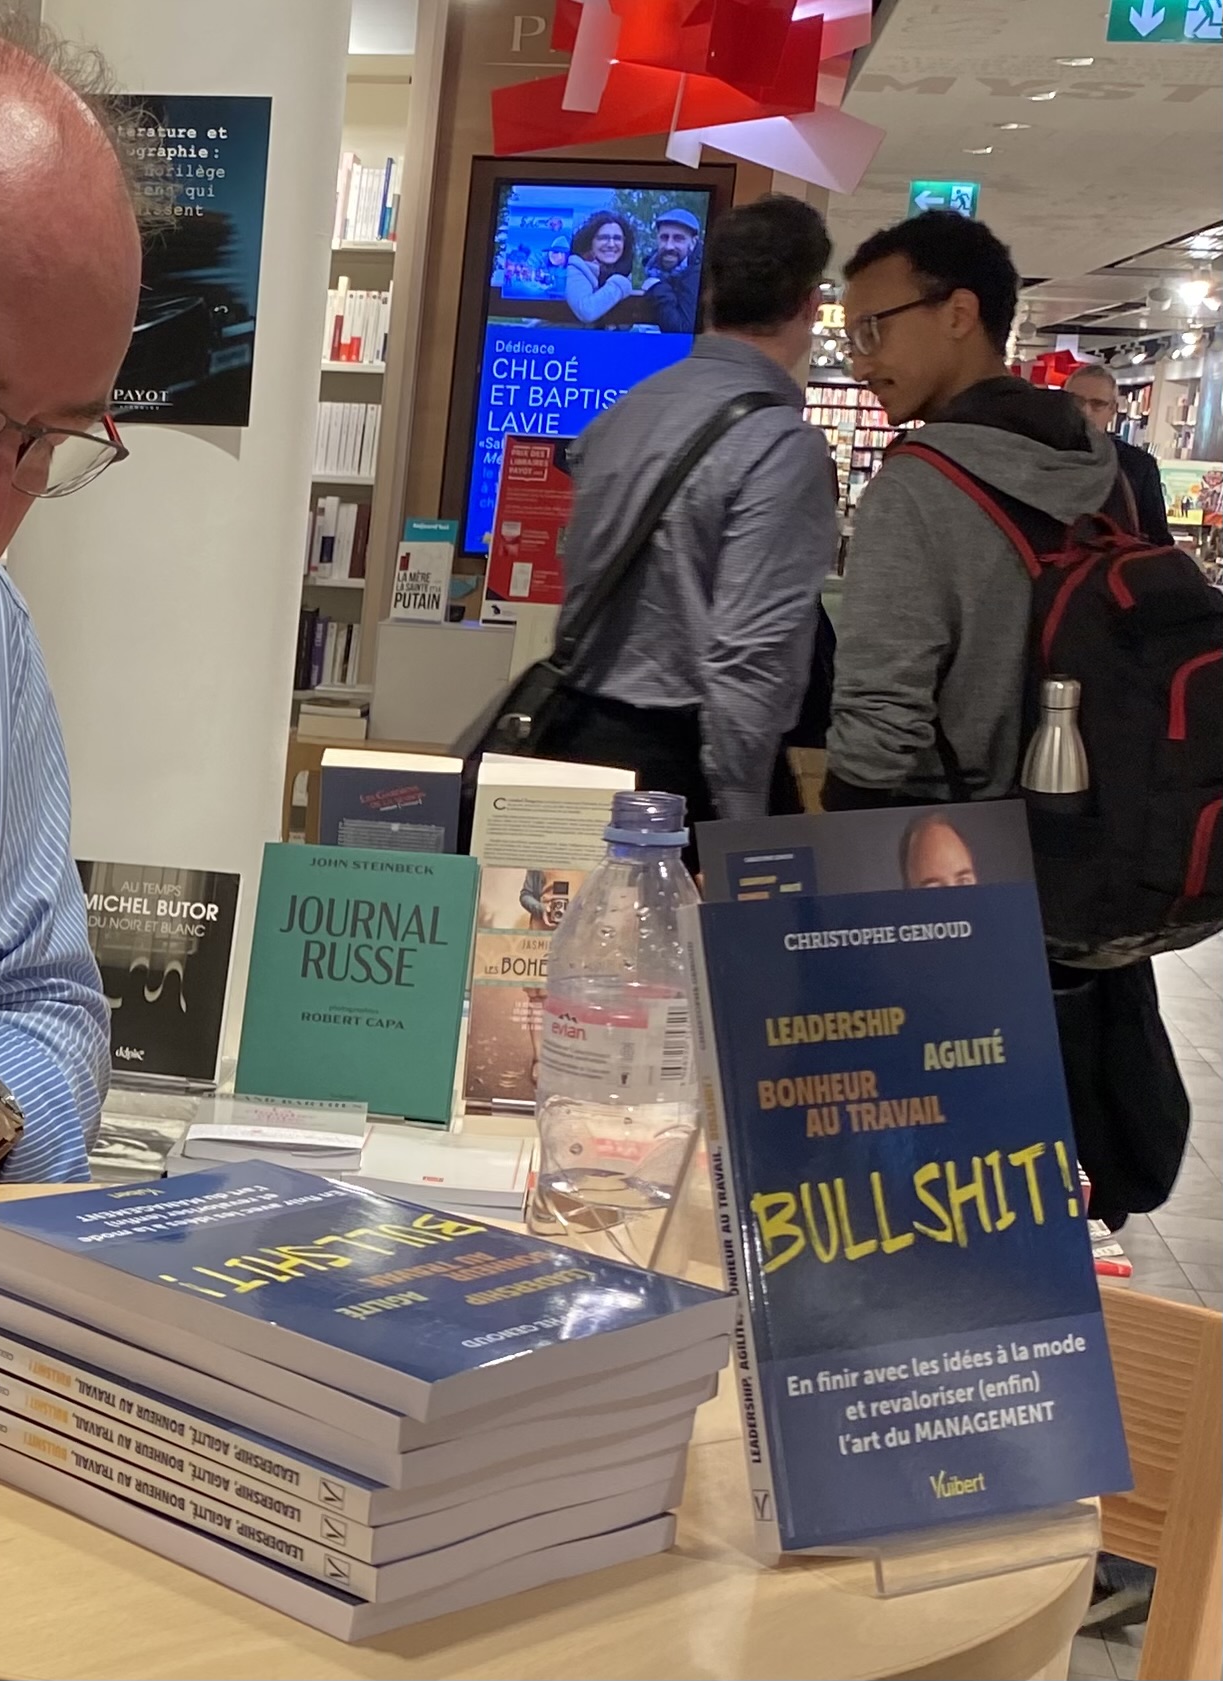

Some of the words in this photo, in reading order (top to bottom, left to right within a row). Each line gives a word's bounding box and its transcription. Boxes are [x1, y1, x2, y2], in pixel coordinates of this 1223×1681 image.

[207, 126, 228, 139] et
[186, 184, 215, 199] qui
[495, 338, 555, 355] Dédicace
[491, 356, 579, 382] CHLOÉ
[114, 388, 169, 402] PAYOT
[490, 384, 521, 406] ET
[487, 412, 560, 435] LAVIE
[396, 583, 405, 592] LA
[397, 572, 407, 583] LA
[409, 569, 431, 584] MÈRE
[394, 592, 441, 610] PUTAIN
[309, 856, 347, 871] JOHN
[351, 860, 435, 877] STEINBECK
[121, 881, 139, 894] AU
[142, 882, 181, 897] TEMPS
[84, 893, 151, 915] MICHEL
[157, 899, 219, 922] BUTOR
[279, 893, 449, 946] JOURNAL
[88, 916, 106, 928] DU
[109, 917, 141, 931] NOIR
[145, 920, 157, 932] ET
[161, 922, 205, 937] BLANC
[784, 926, 896, 951] CHRISTOPHE
[899, 921, 972, 942] GENOUD
[300, 939, 417, 988] RUSSE
[484, 966, 498, 975] LES
[301, 1012, 361, 1026] ROBERT
[366, 1017, 404, 1030] CAPA
[551, 1021, 587, 1041] evian
[765, 1006, 905, 1047] LEADERSHIP
[923, 1028, 1006, 1071] AGILITÉ
[757, 1070, 878, 1110] BONHEUR
[806, 1105, 841, 1138] AU
[846, 1096, 946, 1133] TRAVAIL
[76, 1196, 206, 1223] MANAGEMENT
[202, 1192, 228, 1201] du
[240, 1203, 283, 1214] avec
[77, 1229, 134, 1243] mode
[722, 1214, 732, 1233] AU
[724, 1239, 740, 1296] ONHEUR
[334, 1290, 428, 1320] AGILITÉ
[787, 1375, 813, 1397] En
[816, 1368, 859, 1393] finir
[863, 1364, 908, 1386] avec
[911, 1357, 940, 1378] les
[943, 1349, 993, 1373] idées
[997, 1344, 1009, 1364] à
[1011, 1342, 1028, 1362] la
[1033, 1333, 1086, 1359] mode
[75, 1378, 116, 1407] TRAVAIL,
[120, 1397, 134, 1414] AU
[846, 1401, 867, 1421] et
[871, 1385, 975, 1418] revaloriser
[978, 1370, 1041, 1402] (enfin)
[72, 1413, 114, 1443] TRAVAIL,
[137, 1402, 185, 1436] BONHEUR
[839, 1432, 880, 1456] l'art
[884, 1427, 910, 1447] du
[914, 1401, 1055, 1443] MANAGEMENT
[117, 1433, 131, 1450] AU
[135, 1439, 184, 1472] BONHEUR
[189, 1426, 230, 1456] AGILITÉ,
[70, 1450, 114, 1481] TRAVAIL,
[117, 1471, 131, 1488] AU
[188, 1461, 229, 1491] AGILITÉ,
[233, 1444, 300, 1486] LEADERSHIP,
[135, 1477, 185, 1511] BONHEUR
[929, 1470, 986, 1499] Vuibert
[189, 1500, 231, 1530] AGILITÉ,
[234, 1481, 301, 1522] LEADERSHIP,
[236, 1520, 304, 1561] LEADERSHIP,
